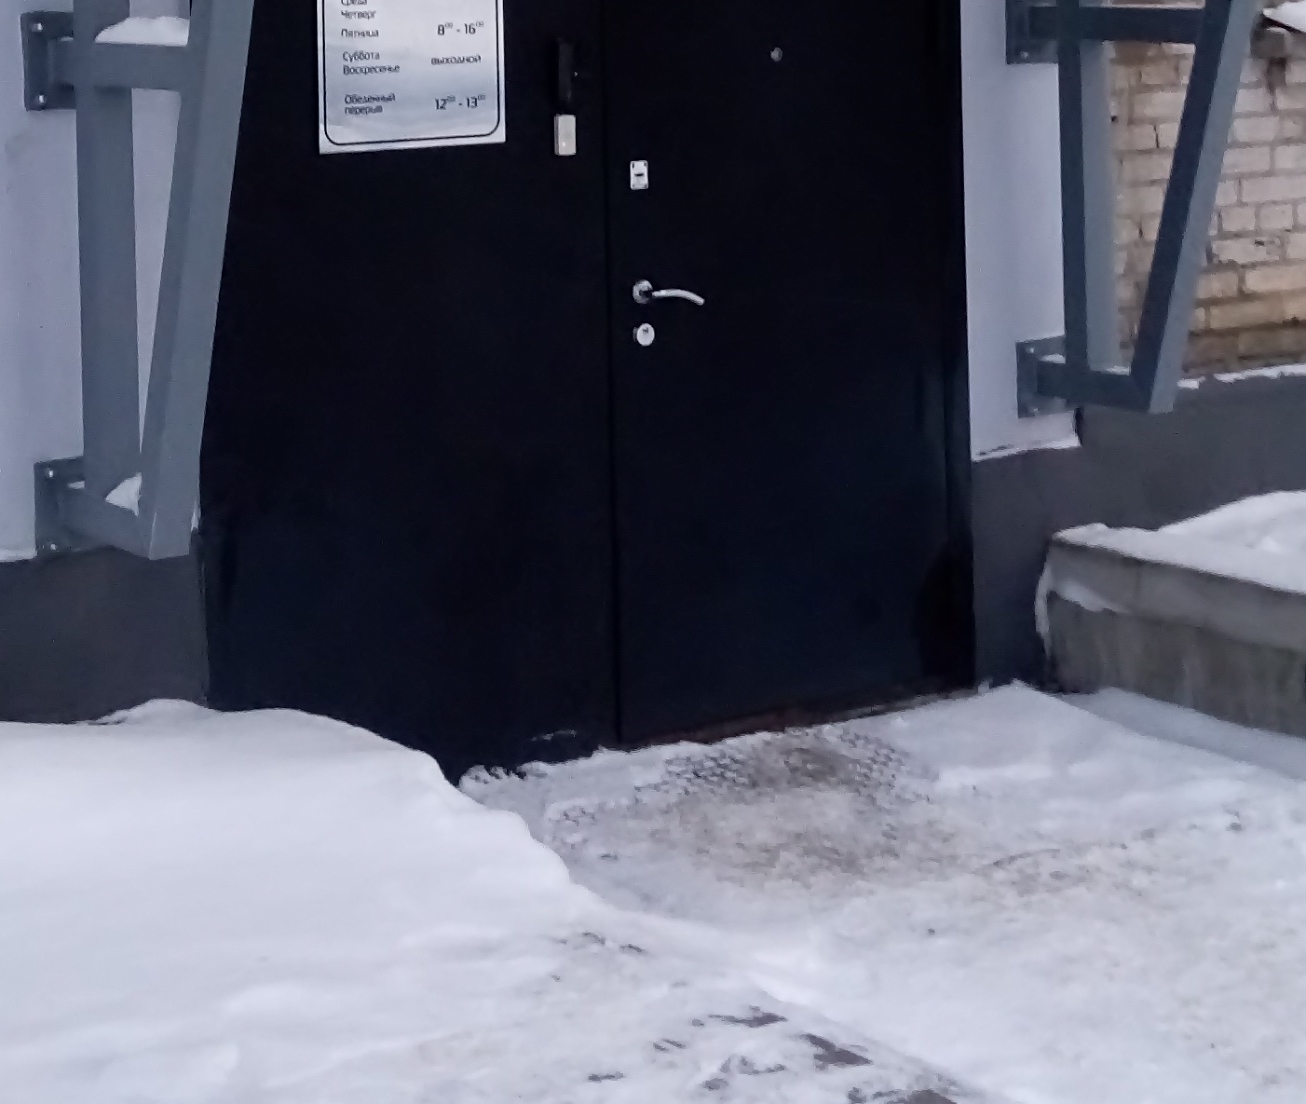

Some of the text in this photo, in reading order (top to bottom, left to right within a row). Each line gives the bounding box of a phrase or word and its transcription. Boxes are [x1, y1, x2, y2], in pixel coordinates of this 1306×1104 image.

[341, 10, 377, 20] Четверг
[341, 28, 379, 38] Пятница
[343, 50, 380, 63] Суббота
[431, 54, 481, 66] выходной
[343, 65, 400, 76] Воскресенье
[344, 92, 396, 105] Обеденный
[344, 105, 383, 116] перерыв
